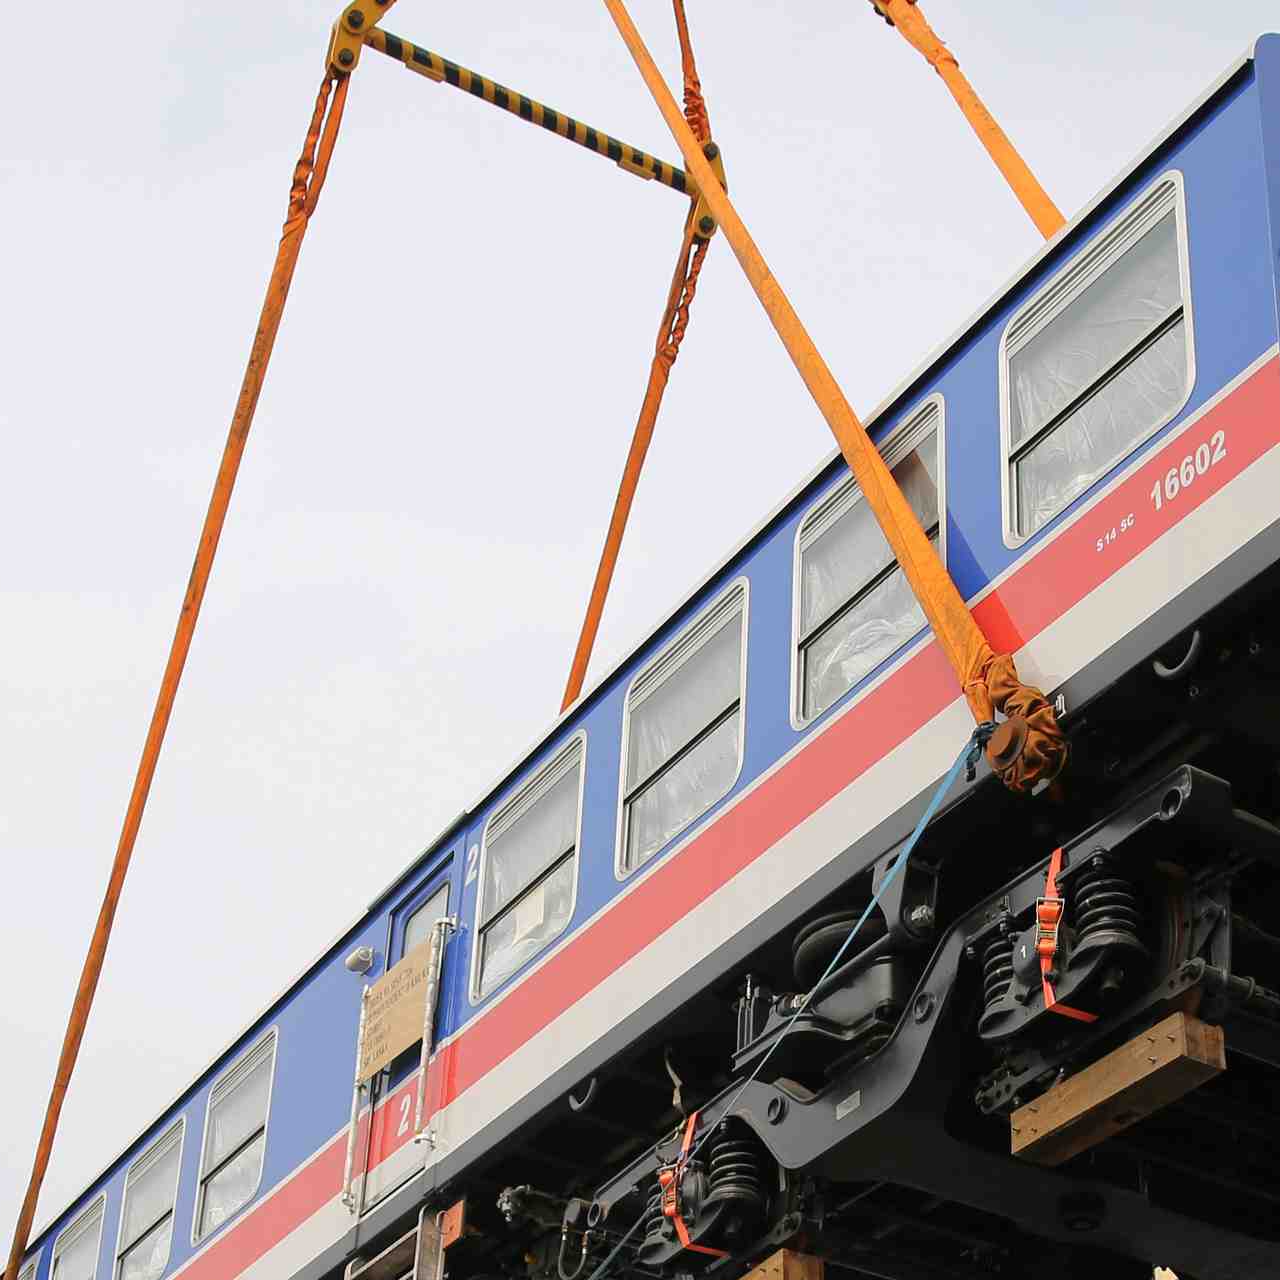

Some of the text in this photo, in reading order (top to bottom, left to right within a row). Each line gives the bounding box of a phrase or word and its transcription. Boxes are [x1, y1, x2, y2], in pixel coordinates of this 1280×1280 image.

[1150, 429, 1227, 512] 16602
[464, 844, 478, 887] 2
[397, 1094, 412, 1137] 2
